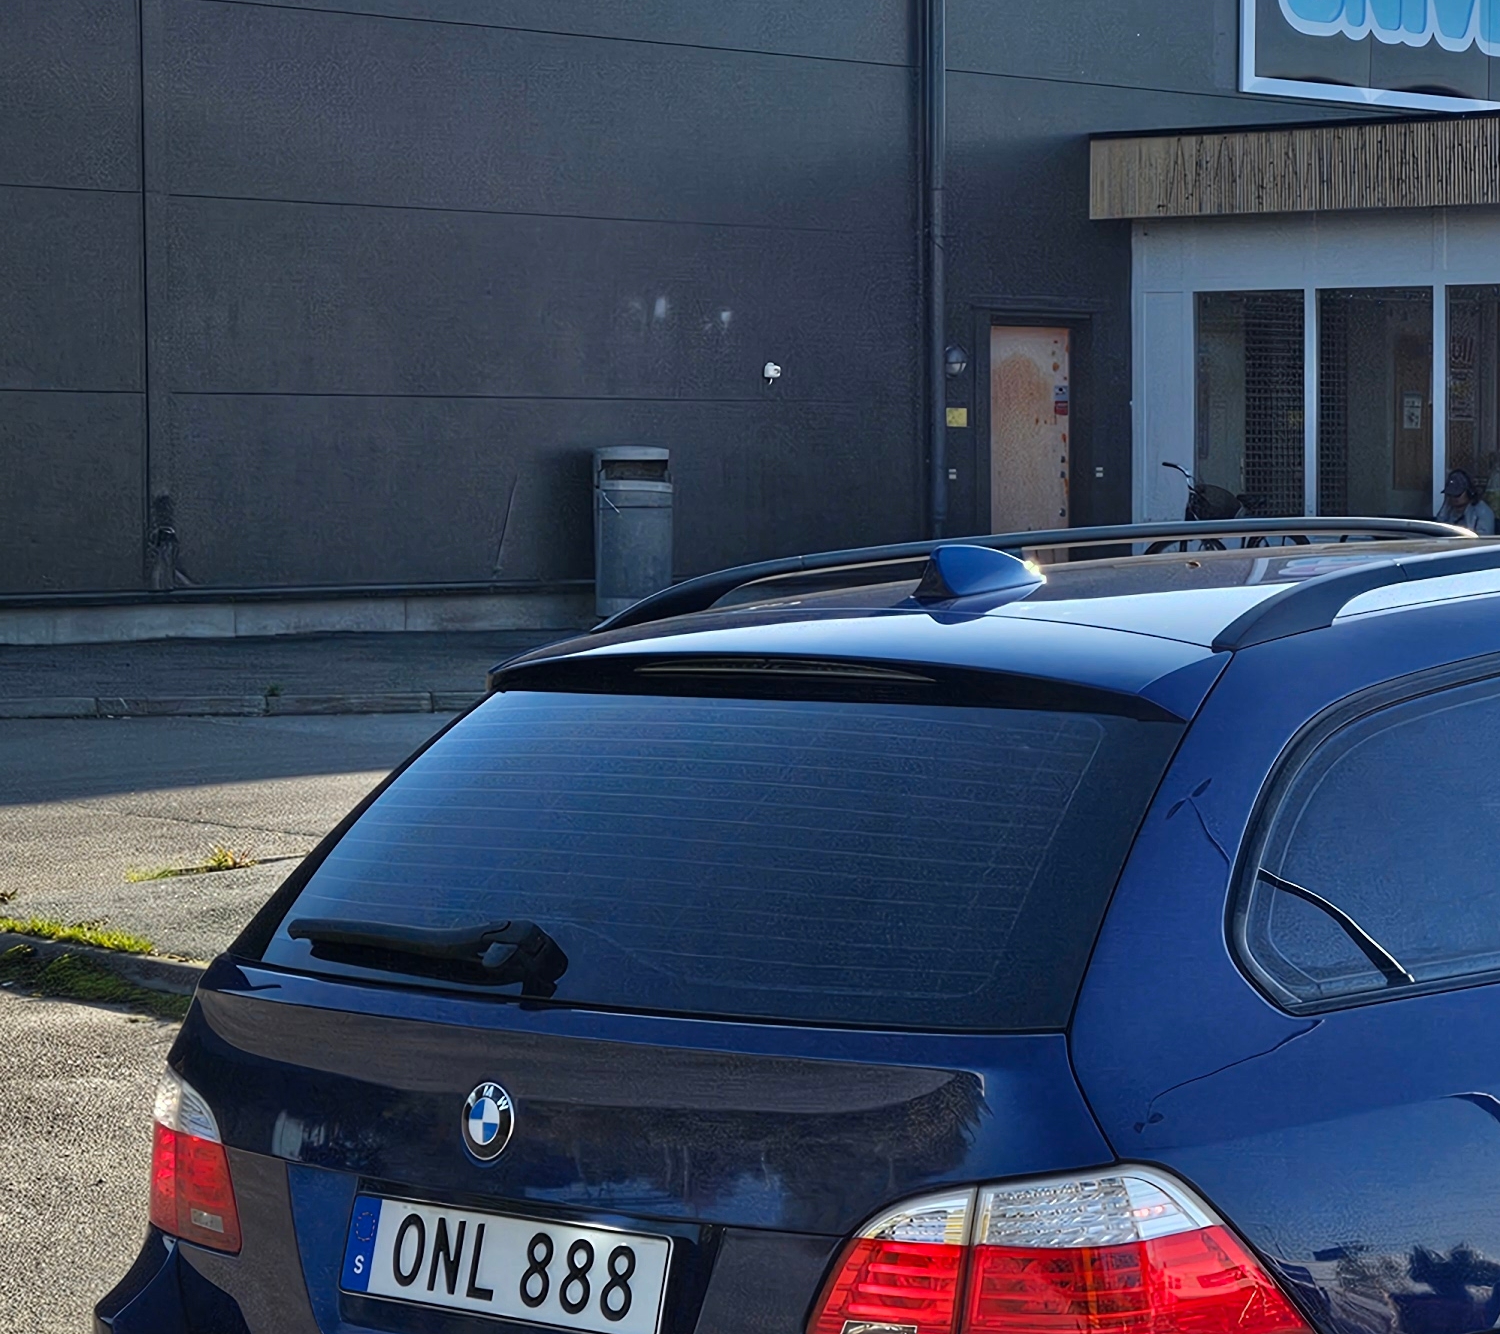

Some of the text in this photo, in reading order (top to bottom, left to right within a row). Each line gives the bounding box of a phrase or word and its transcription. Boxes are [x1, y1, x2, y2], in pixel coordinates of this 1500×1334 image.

[468, 1084, 509, 1111] MW
[353, 1255, 364, 1274] S
[393, 1213, 636, 1321] ONL 888
